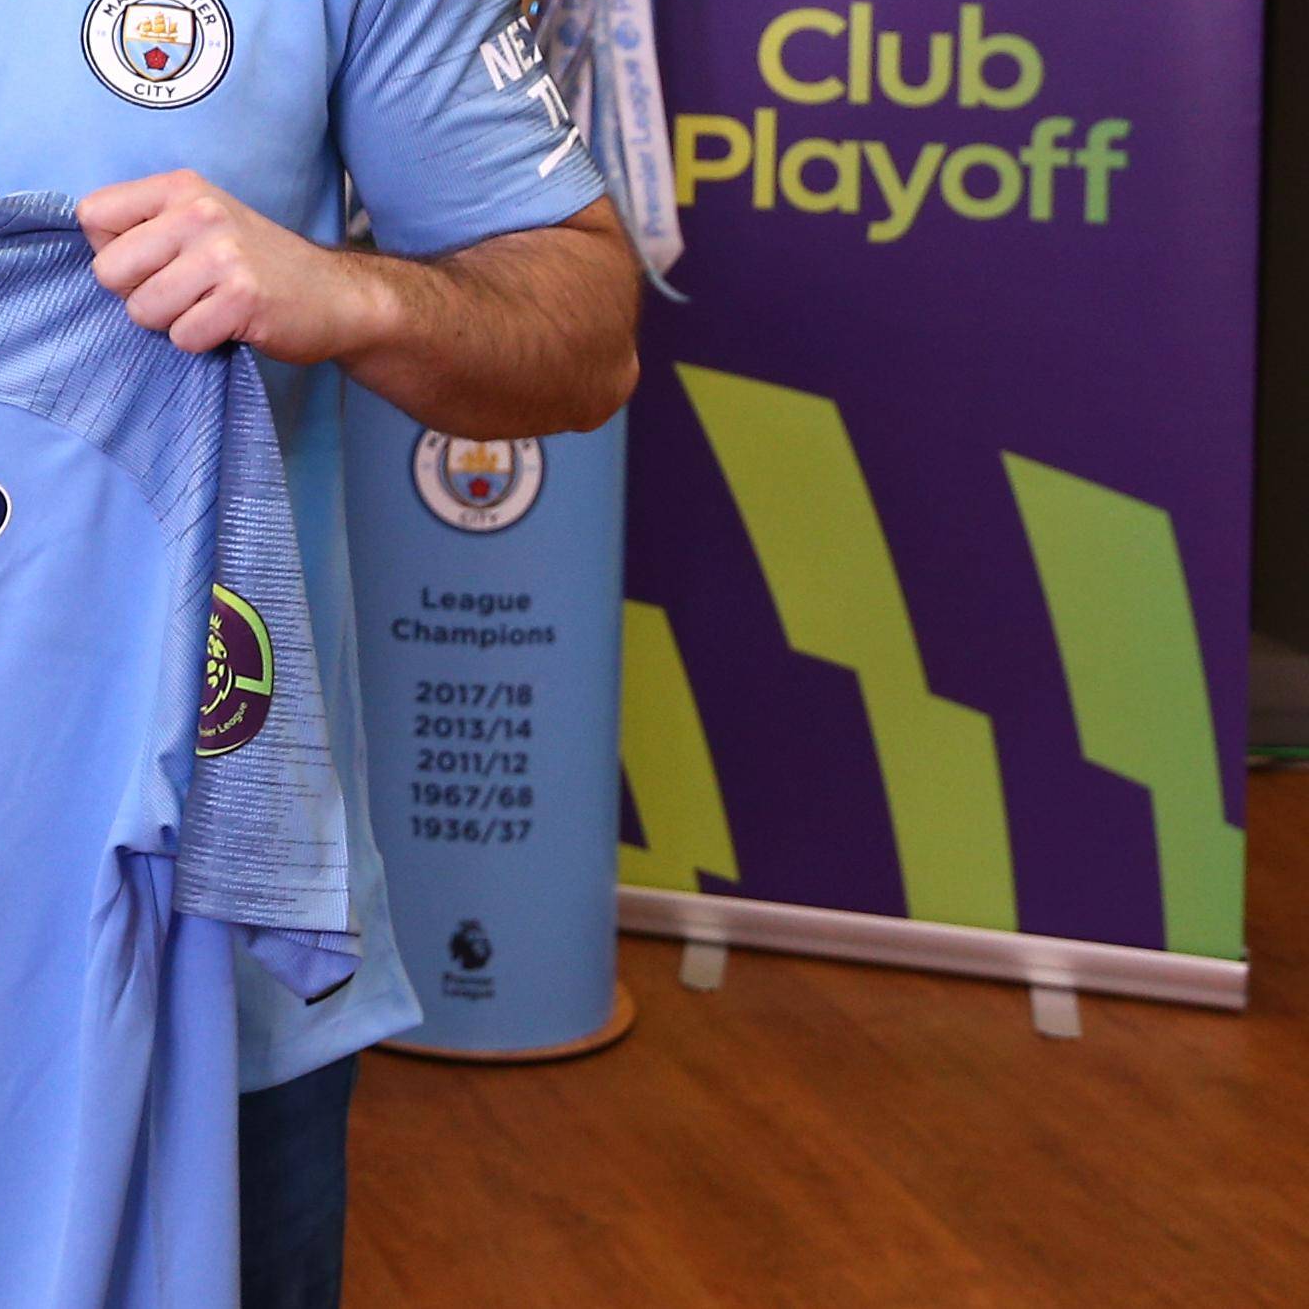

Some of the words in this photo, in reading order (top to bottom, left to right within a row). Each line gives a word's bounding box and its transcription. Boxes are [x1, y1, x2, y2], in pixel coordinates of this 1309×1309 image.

[757, 0, 1044, 110] Club
[133, 83, 177, 99] CITY
[674, 107, 1132, 243] Playoff
[421, 587, 532, 616] League
[390, 616, 556, 648] Champions
[415, 680, 533, 709] 2017/18
[217, 701, 248, 734] League
[414, 712, 532, 742] 2013/14
[416, 747, 529, 777] 2011/12
[410, 780, 533, 811] 1967/68
[410, 814, 532, 845] 1936/37
